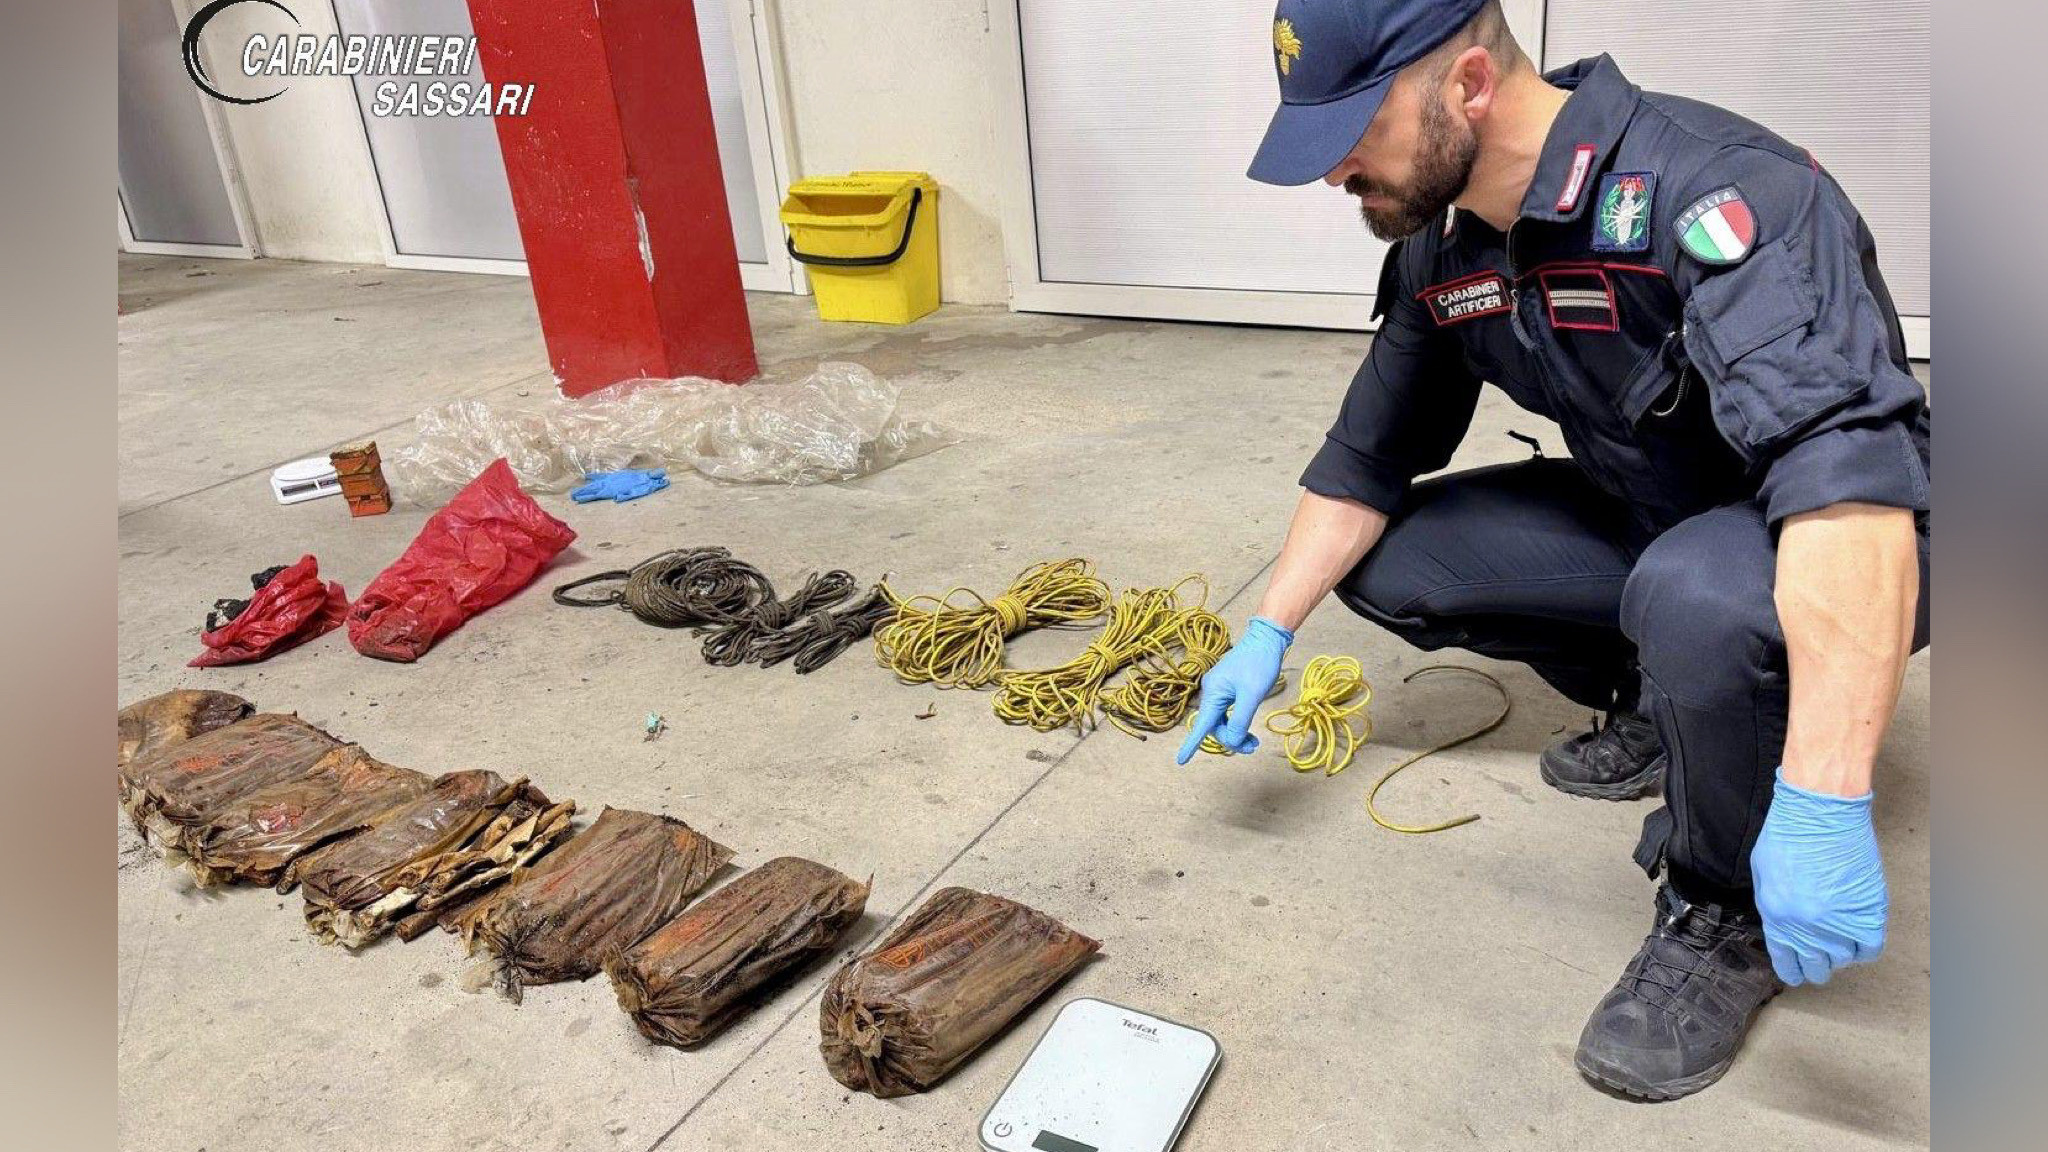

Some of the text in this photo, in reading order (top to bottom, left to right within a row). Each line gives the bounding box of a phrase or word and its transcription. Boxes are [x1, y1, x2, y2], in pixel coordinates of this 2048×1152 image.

[1680, 192, 1732, 226] ITALIA
[1438, 281, 1500, 306] CARABINIERI
[1448, 295, 1502, 318] ARTIFICIERI
[1122, 1018, 1158, 1036] Tefal
